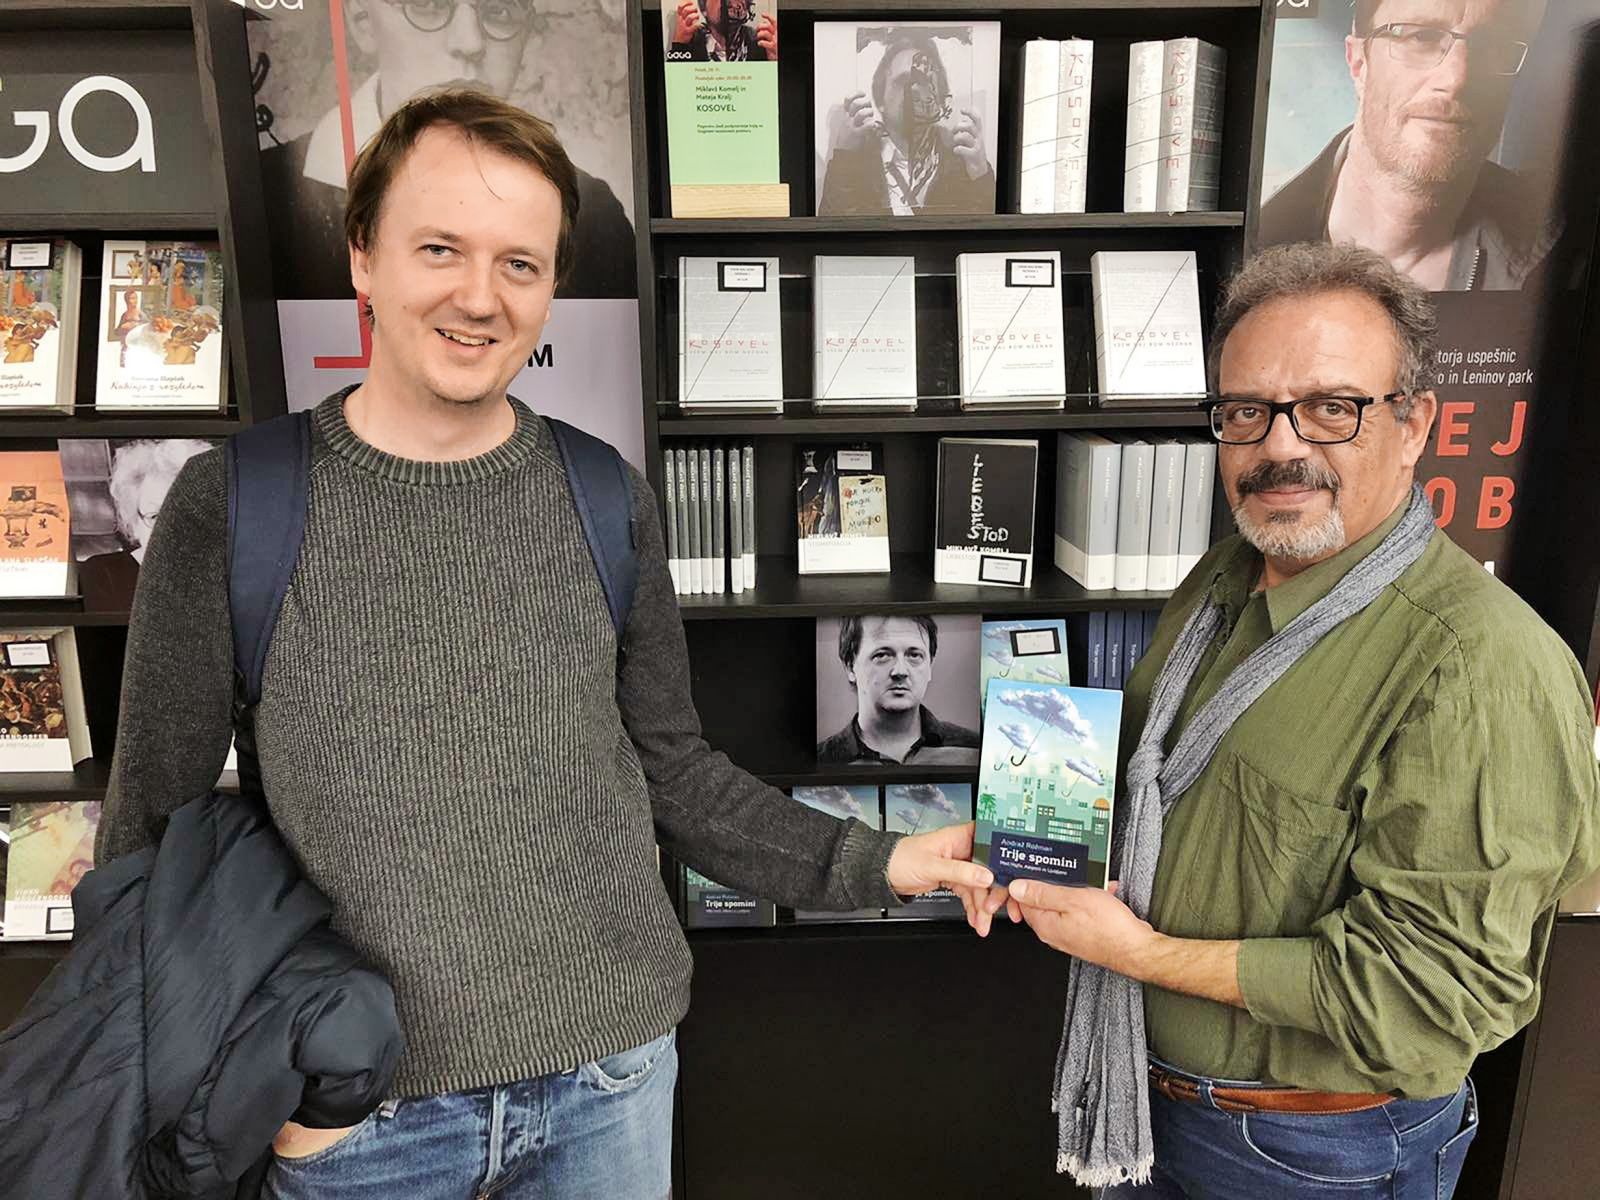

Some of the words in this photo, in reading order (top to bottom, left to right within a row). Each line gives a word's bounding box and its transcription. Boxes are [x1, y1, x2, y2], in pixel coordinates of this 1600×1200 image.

[719, 85, 739, 93] Komelj
[697, 104, 737, 112] KOSOVEL
[1068, 53, 1084, 191] KOSOVEL
[972, 333, 1053, 344] KOSOVEL
[1113, 331, 1190, 341] KOSOVEL
[689, 338, 769, 349] KOSOVEL
[825, 337, 905, 347] KOSOVEL
[1467, 348, 1516, 365] uspešnic
[1448, 372, 1458, 384] in
[1462, 369, 1505, 384] Leninov
[1508, 369, 1533, 387] park
[945, 545, 978, 553] MIKLAVŽ
[979, 546, 1009, 554] KOMELJ
[1000, 847, 1026, 862] Trije
[1029, 853, 1077, 869] spomini
[705, 900, 723, 908] Trije
[724, 900, 756, 908] spomini
